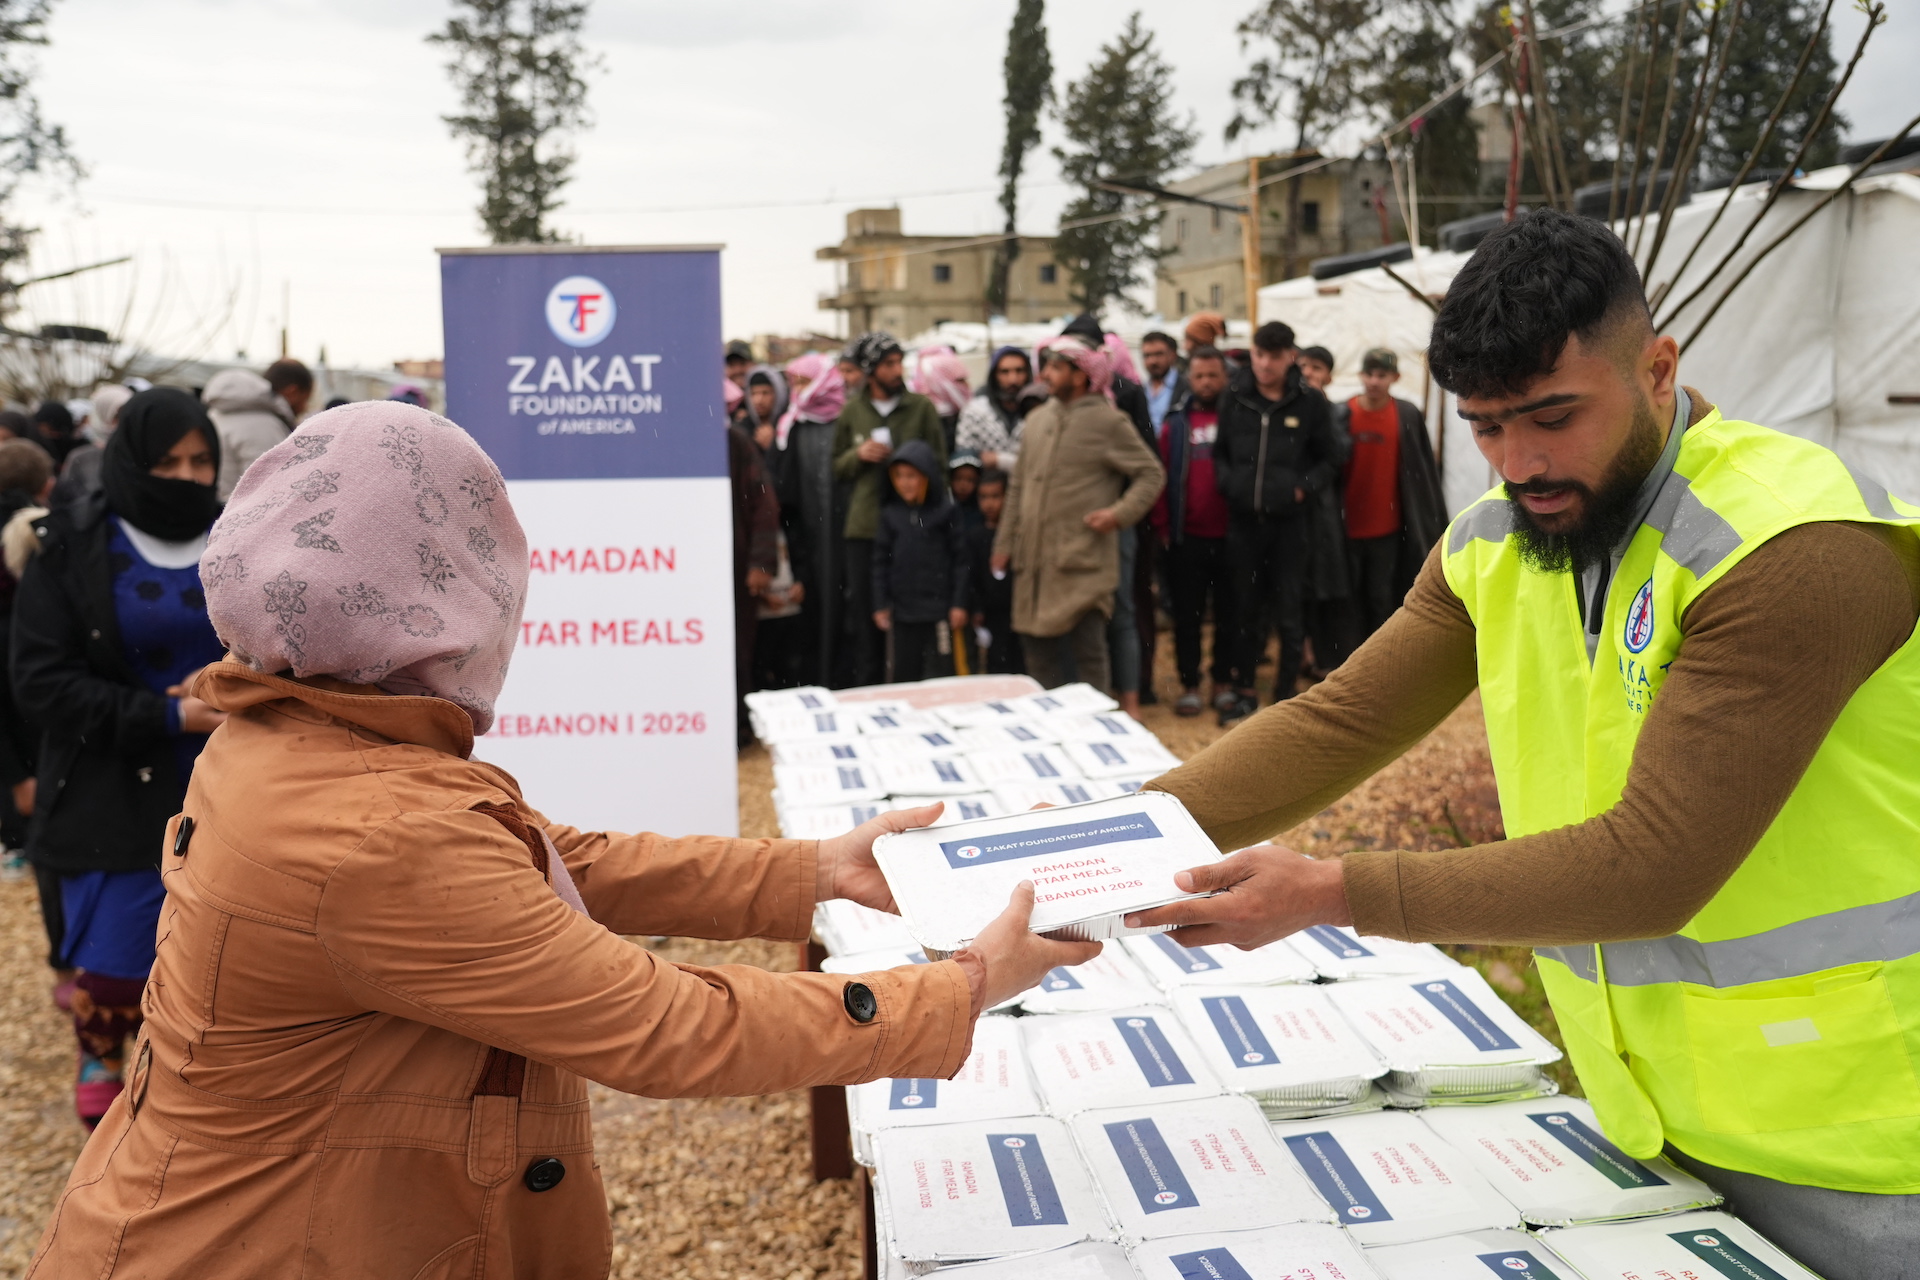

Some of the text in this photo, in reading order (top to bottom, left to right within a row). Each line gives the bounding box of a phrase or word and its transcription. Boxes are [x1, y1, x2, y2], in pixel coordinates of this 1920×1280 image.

[507, 355, 662, 393] ZAKAT
[509, 394, 662, 416] FOUNDATION
[537, 418, 636, 435] of AMERICA
[530, 547, 676, 573] AMADAN
[522, 618, 705, 646] TAR MEALS
[642, 711, 706, 735] 2026
[985, 842, 1018, 853] ZAKAT
[1019, 832, 1086, 848] FOUNDATION
[1100, 823, 1144, 834] AMERICA
[1032, 857, 1106, 874] RAMADAN
[1034, 865, 1122, 886] FTAR MEALS
[1034, 887, 1099, 904] EBANON
[1109, 879, 1143, 891] 2026
[1126, 1124, 1140, 1142] AMERICA
[1012, 1149, 1024, 1162] ZAKAT
[1138, 1147, 1158, 1175] FOUNDATION
[1190, 1140, 1214, 1170] RAMADAN
[1206, 1134, 1235, 1172] IFTAR MEALS
[1240, 1146, 1267, 1175] LEBANON
[1480, 1140, 1511, 1164] LEBANON
[1526, 1154, 1552, 1173] MEALS
[1528, 1140, 1564, 1167] RAMADAN
[913, 1162, 928, 1188] LEBANON
[962, 1162, 977, 1194] RAMADAN
[1017, 1162, 1032, 1191] FOUNDATION
[1322, 1159, 1347, 1190] FOUNDATION
[1372, 1152, 1400, 1184] RAMADAN
[1387, 1147, 1422, 1184] IFTAR MEALS
[1422, 1157, 1452, 1184] LEBANON
[942, 1160, 959, 1200] IFTAR MEALS
[1152, 1175, 1167, 1191] ZAKAT
[919, 1193, 932, 1208] 2026
[1028, 1197, 1042, 1220] AMERICA
[1342, 1190, 1358, 1205] ZAKAT
[1713, 1248, 1742, 1265] ZAKAT
